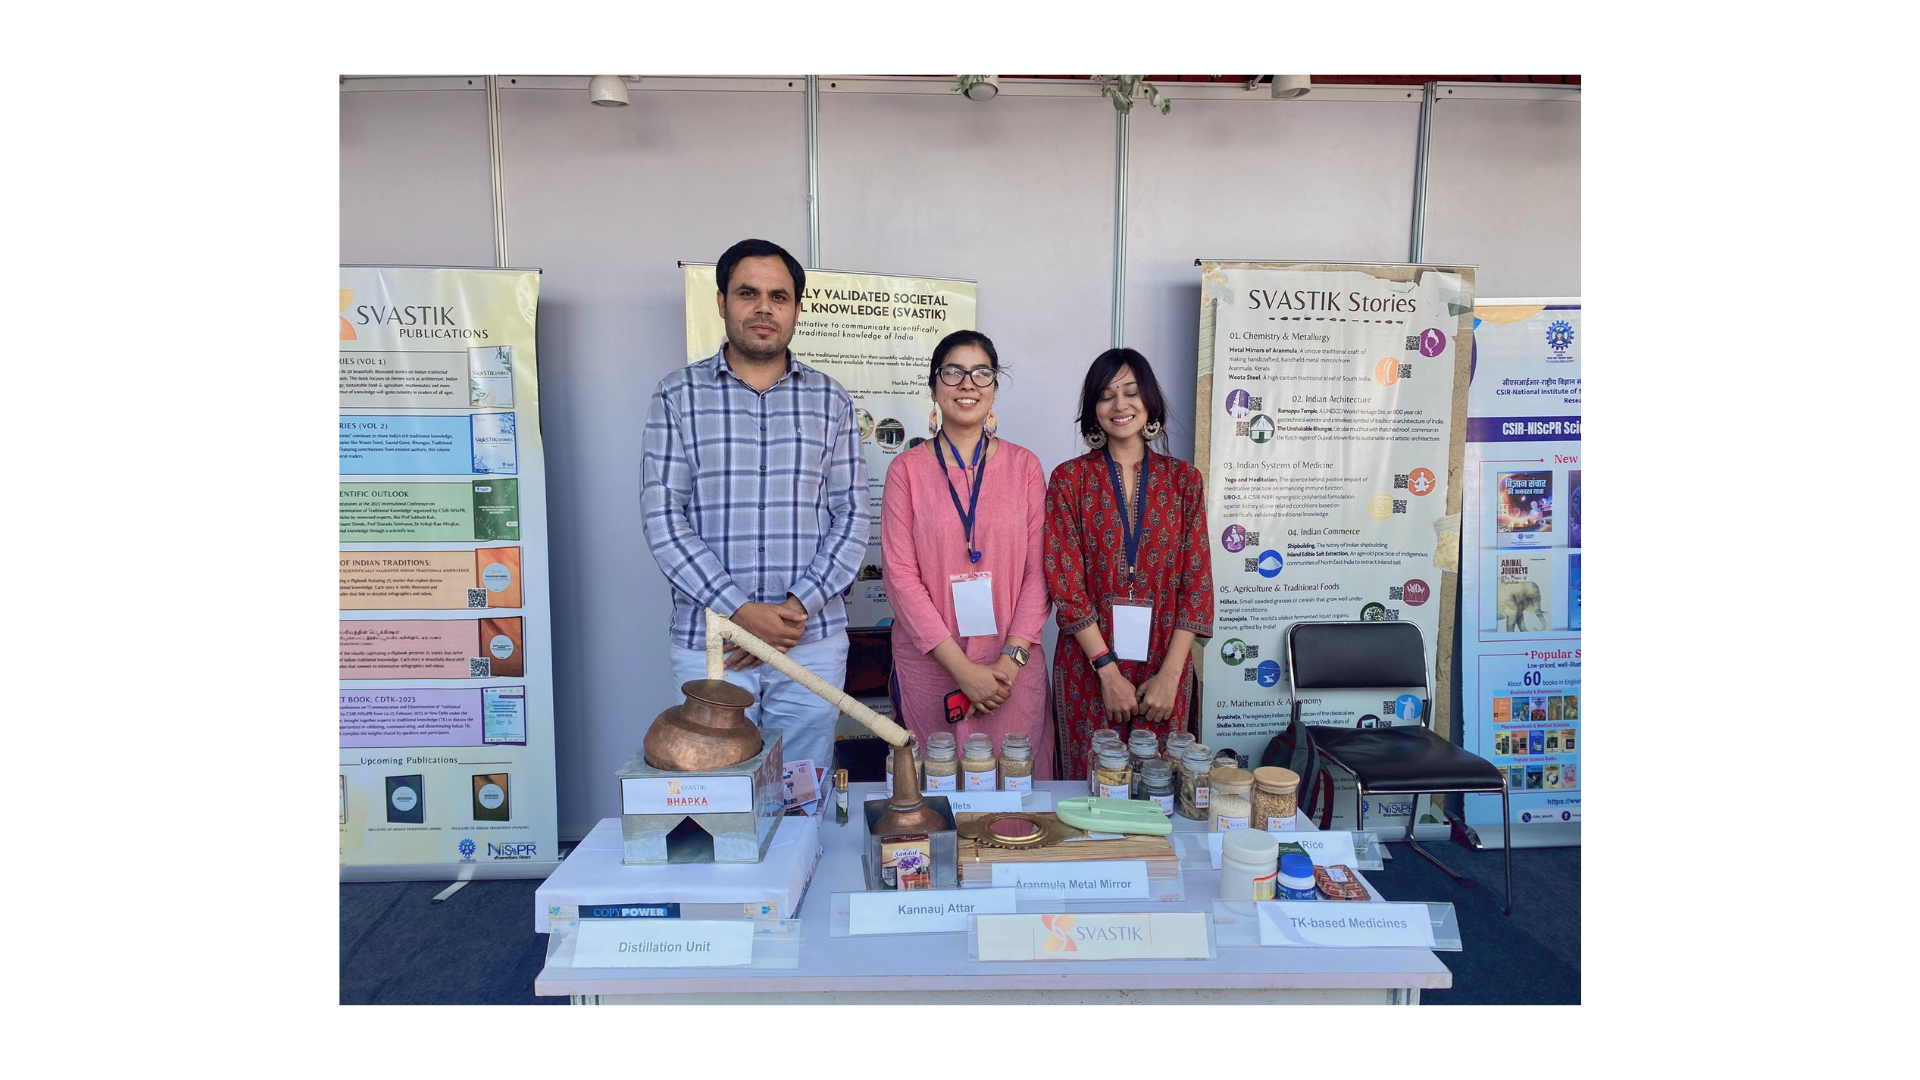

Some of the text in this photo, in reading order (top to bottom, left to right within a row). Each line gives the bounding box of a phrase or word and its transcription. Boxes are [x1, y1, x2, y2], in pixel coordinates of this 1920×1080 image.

[825, 289, 890, 302] VALIDATED
[894, 293, 948, 306] SOCIETAL
[1249, 290, 1417, 313] SVASTIK Stories
[357, 306, 455, 326] SVASTIK
[812, 303, 889, 316] KNOWLEDGE
[893, 307, 946, 320] (SVASTIK)
[400, 329, 488, 338] PUBLICATIONS
[893, 325, 939, 334] scientifically
[842, 332, 881, 341] knowledge
[1243, 333, 1280, 341] Chemistry
[1292, 333, 1330, 342] Metallurgy
[1503, 421, 1561, 435] CSIR-NIScPR
[1554, 455, 1578, 463] New
[1234, 585, 1272, 594] Agriculture
[1531, 650, 1572, 661] Popular
[1524, 671, 1541, 686] 60
[360, 757, 403, 766] Upcoming
[667, 797, 707, 805] BHAPKA
[1016, 880, 1131, 890] Aranmula Metal Mirror
[622, 908, 664, 917] POWER
[898, 904, 975, 916] Kannauj Attar
[1290, 918, 1407, 928] TK-based Medicines
[1076, 927, 1143, 940] SVASTIK
[619, 942, 710, 952] Distillation Unit
